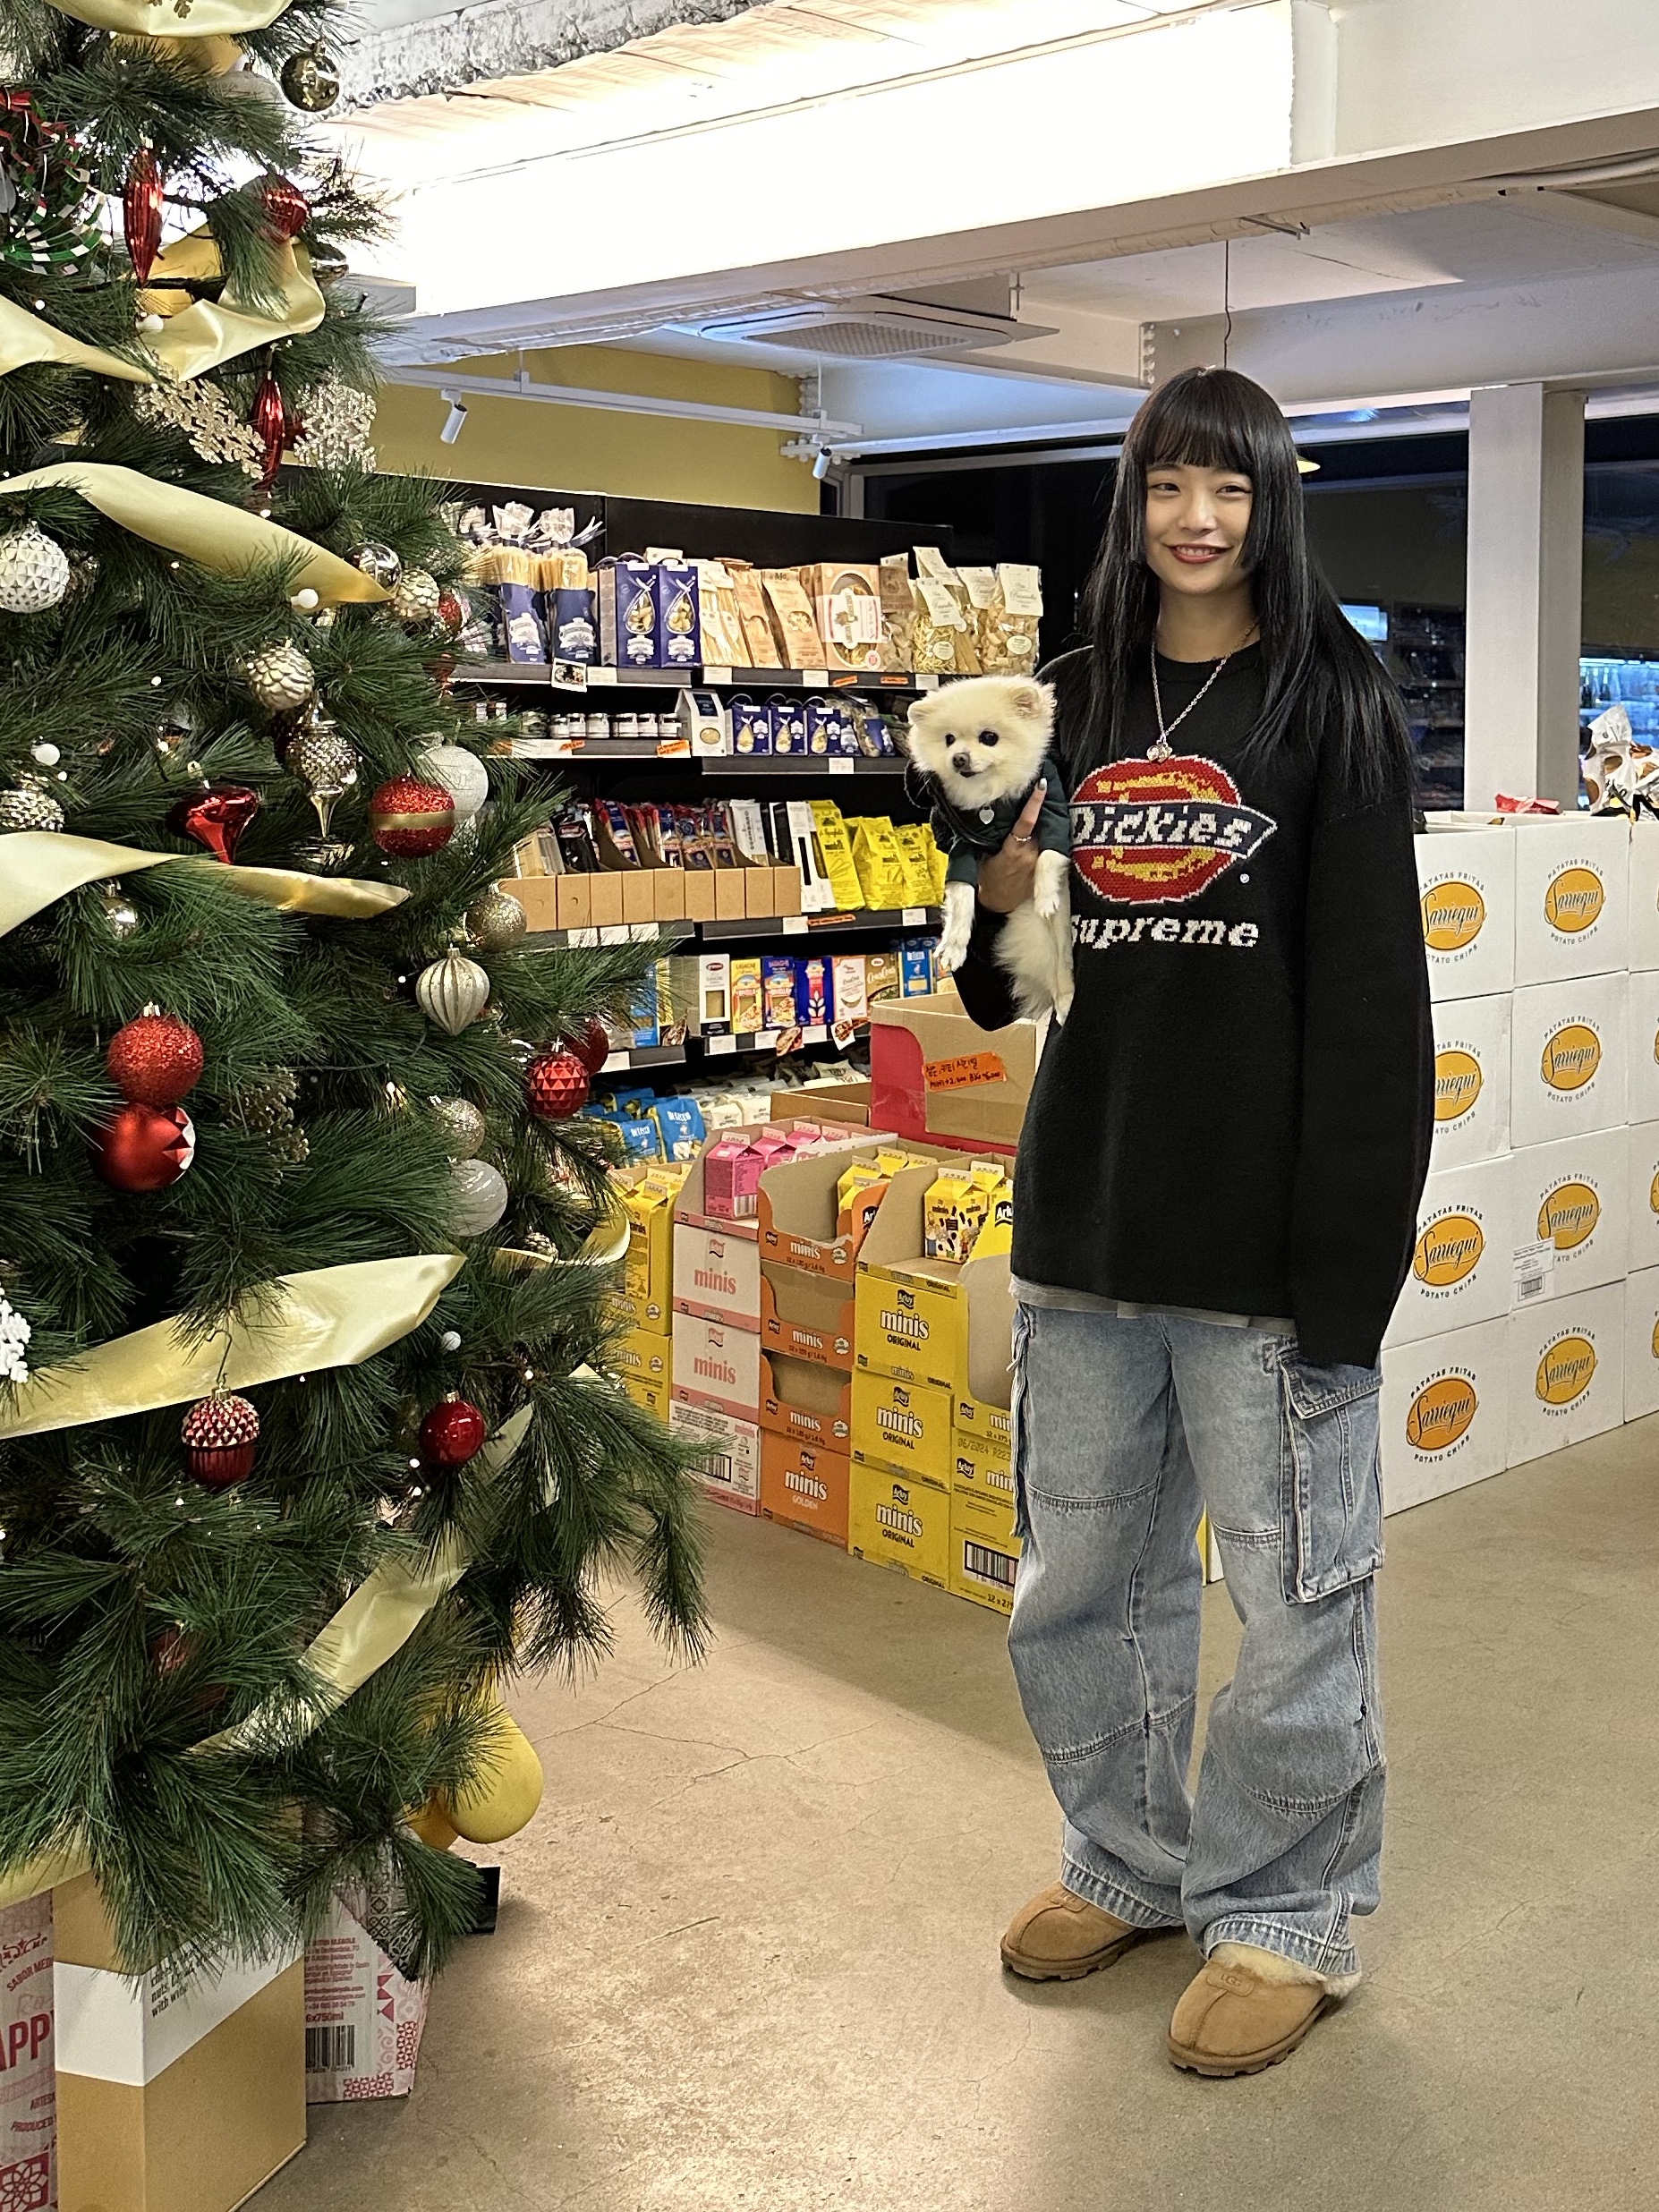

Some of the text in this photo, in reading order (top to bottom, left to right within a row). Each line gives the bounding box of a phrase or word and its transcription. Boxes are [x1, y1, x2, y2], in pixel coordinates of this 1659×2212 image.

[1070, 805, 1252, 847] Dickies
[1419, 872, 1485, 891] ATATAS FRITAS
[1547, 858, 1604, 881] PATATAS FRITAS
[1550, 925, 1599, 944] POTATO CHIPS
[1425, 943, 1478, 964] OTATO CHIPS
[1544, 1016, 1601, 1040] PATATAS FRITAS
[1455, 1041, 1481, 1058] FRITAS
[1547, 1081, 1595, 1102] POTATO CHIPS
[1434, 1110, 1476, 1135] ATO CHIPS
[1540, 1173, 1599, 1200] PATATAS FRITAS
[996, 1206, 1014, 1221] Arlu
[1417, 1204, 1484, 1233] PATATAS FRITAS
[790, 1240, 821, 1260] minis
[1555, 1254, 1570, 1263] ATO
[1573, 1238, 1594, 1258] CHIPS
[694, 1268, 736, 1295] minis
[1420, 1273, 1477, 1299] POTATO CHIPS
[881, 1309, 930, 1340] minis
[792, 1329, 823, 1349] minis
[887, 1334, 921, 1351] ORIGINAL
[1539, 1327, 1595, 1356] PATATAS FRITAS
[694, 1357, 736, 1384] minis
[1411, 1366, 1476, 1399] PATATAS FRITAS
[1543, 1390, 1591, 1417] POTATO CHIPS
[790, 1410, 821, 1432] minis
[876, 1406, 923, 1439] minis
[882, 1432, 915, 1450] ORIGINAL
[1414, 1434, 1470, 1464] POTATO CHIPS
[785, 1469, 828, 1501] minis
[986, 1470, 1014, 1493] min
[876, 1502, 923, 1537] minis
[881, 1528, 915, 1548] ORIGINAL
[987, 1593, 996, 1604] 12
[7, 1967, 33, 1992] SABOR
